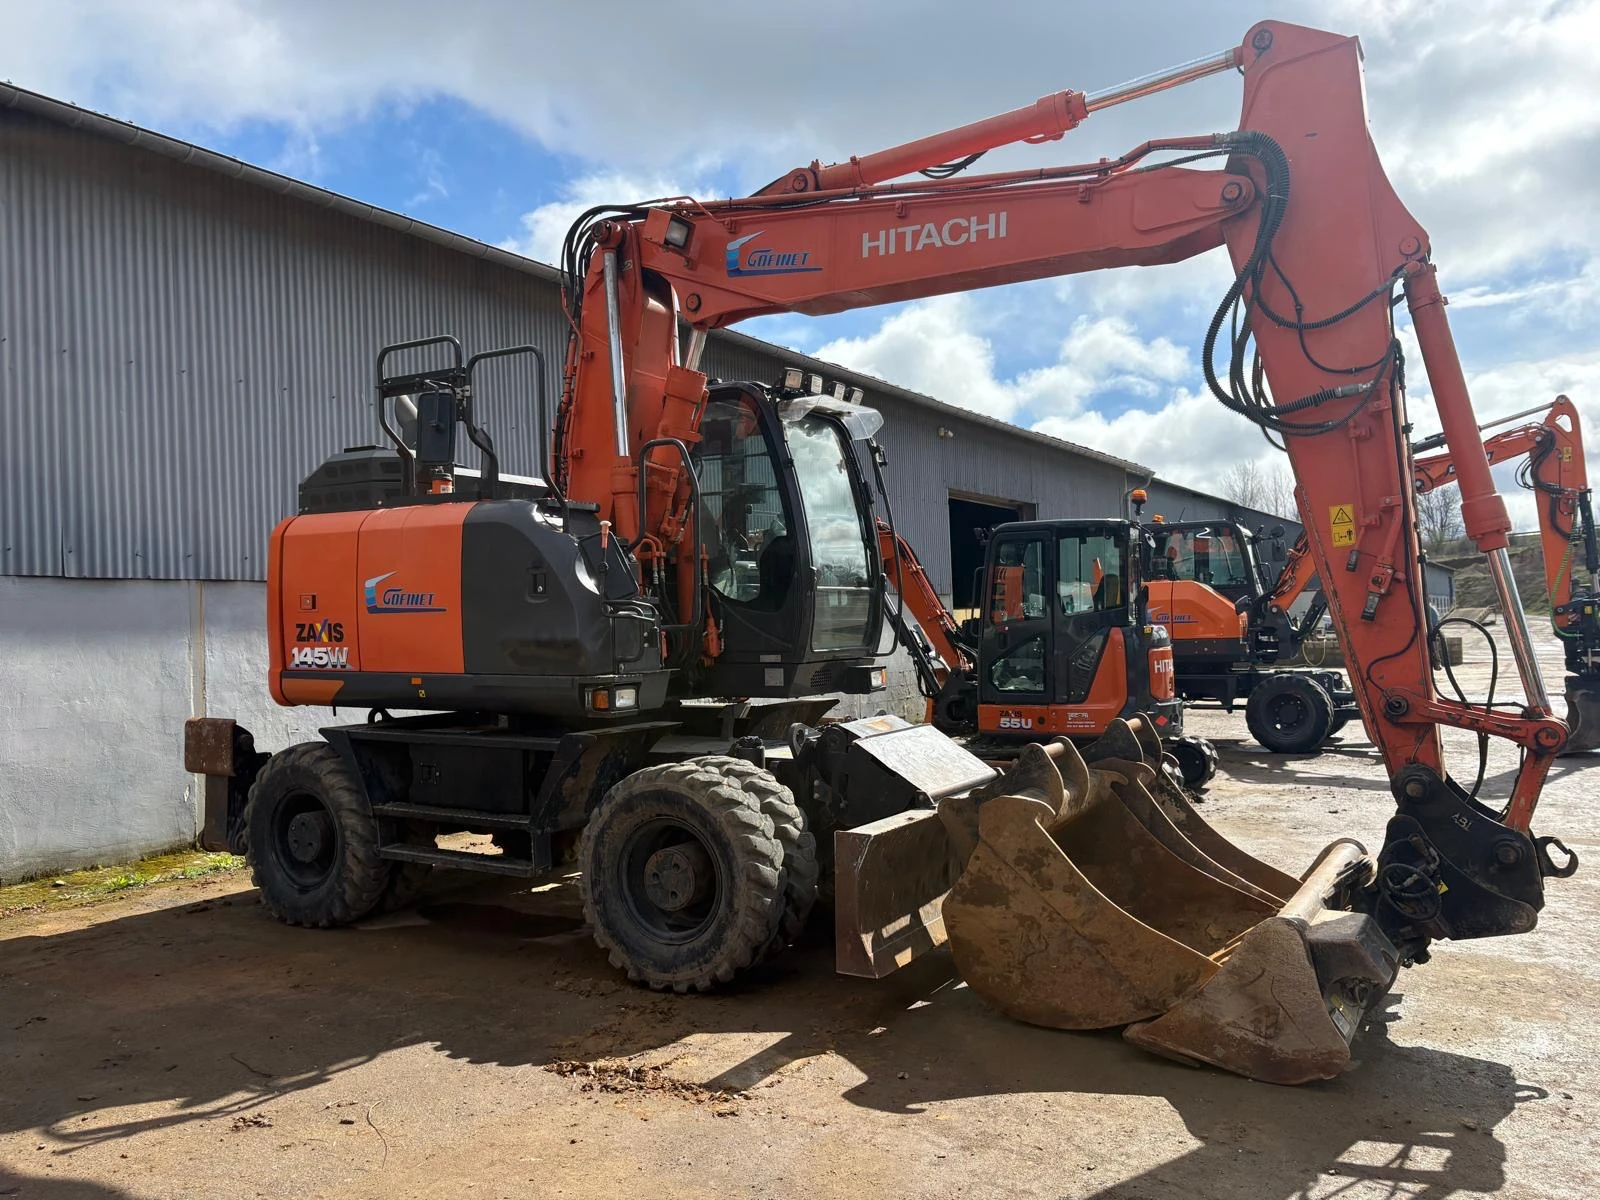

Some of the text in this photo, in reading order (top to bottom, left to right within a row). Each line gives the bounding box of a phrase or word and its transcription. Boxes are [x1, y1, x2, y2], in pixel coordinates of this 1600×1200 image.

[862, 211, 1007, 258] HITACHI
[747, 248, 811, 267] GOFINET
[382, 588, 436, 606] GOFINET
[295, 618, 345, 643] ZAXIS
[291, 646, 350, 668] 145W
[1000, 717, 1033, 729] 55U
